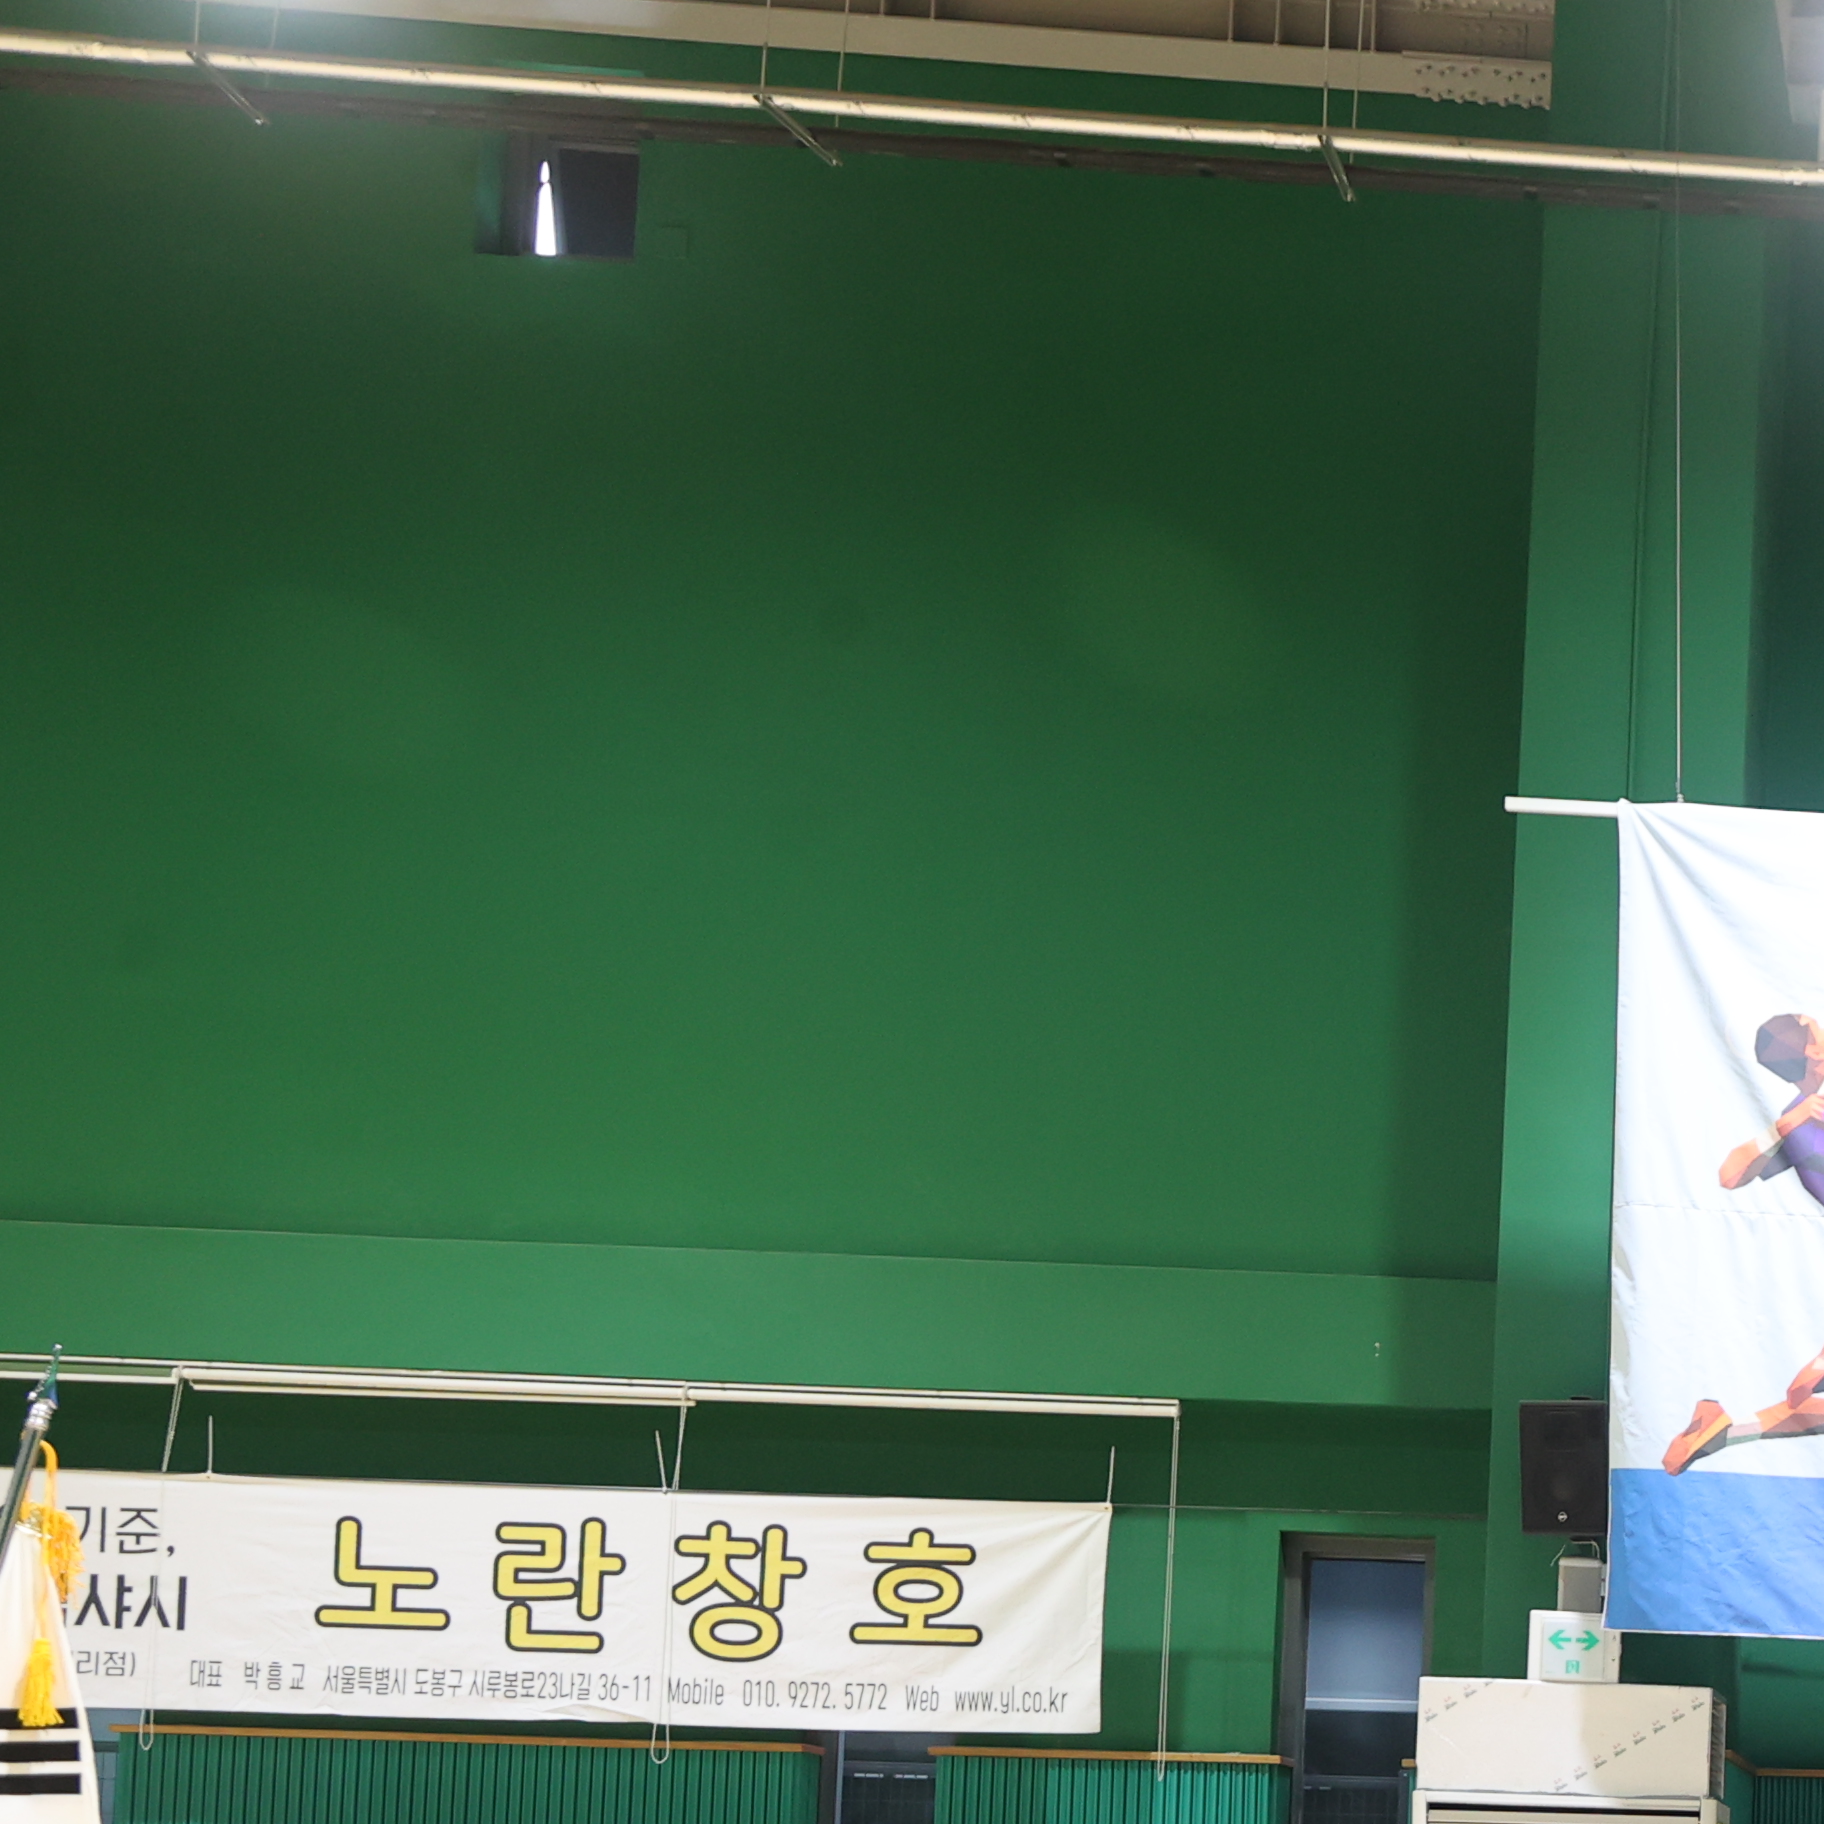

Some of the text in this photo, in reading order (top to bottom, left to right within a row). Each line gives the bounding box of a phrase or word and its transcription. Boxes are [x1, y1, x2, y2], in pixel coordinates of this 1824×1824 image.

[190, 1659, 223, 1689] 대표
[322, 1664, 407, 1696] 서울특별시
[414, 1668, 463, 1697] 도봉구
[468, 1669, 592, 1702] 시루봉로23나길
[598, 1673, 651, 1702] 36-11
[667, 1676, 725, 1707] Mobile
[844, 1682, 888, 1711] 5772
[905, 1684, 940, 1713] Web
[955, 1686, 1070, 1715] www.yl.co.kr
